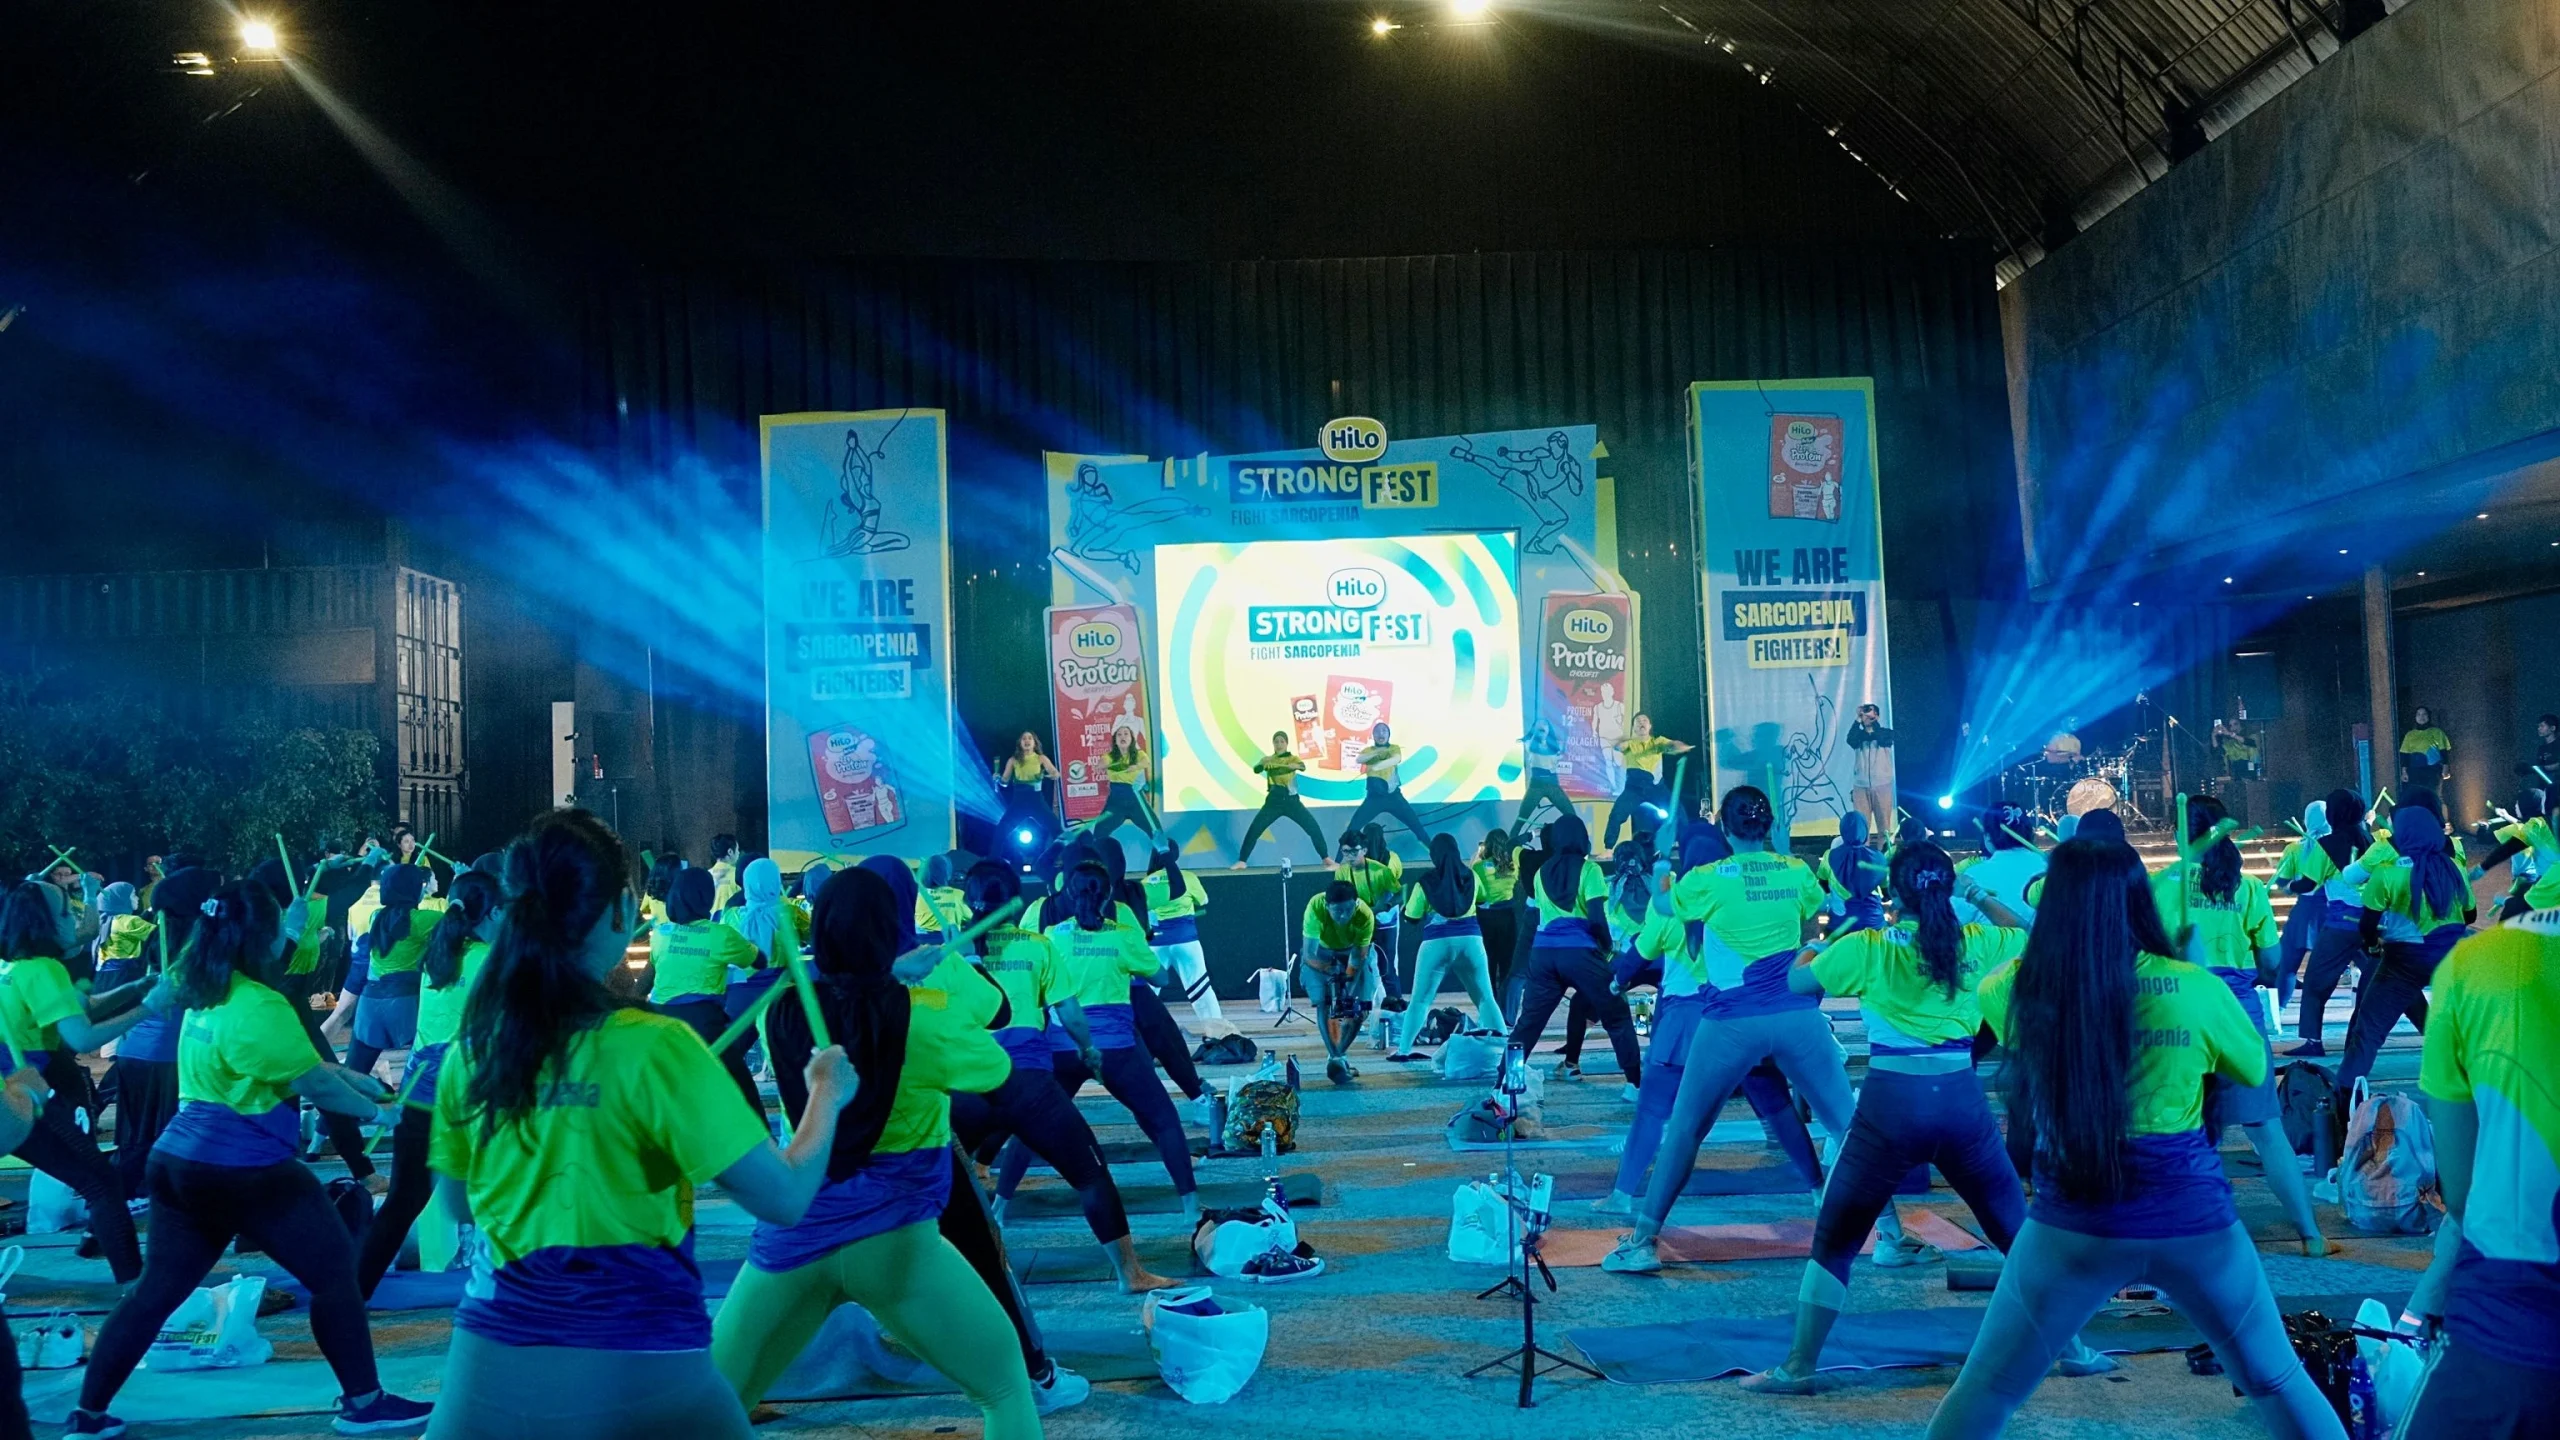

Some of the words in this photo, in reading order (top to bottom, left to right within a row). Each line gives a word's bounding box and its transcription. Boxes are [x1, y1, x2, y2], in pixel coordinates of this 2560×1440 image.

[1330, 425, 1379, 449] HiLo
[1791, 426, 1812, 435] HiLo
[1238, 465, 1359, 499] STRONG
[1369, 470, 1431, 505] FEST
[1231, 509, 1268, 526] FIGHT
[1271, 506, 1361, 525] SARCOPENIA
[1734, 549, 1781, 586] WE
[1792, 547, 1849, 585] ARE
[1336, 578, 1378, 596] HiLo
[800, 579, 846, 618] WE
[857, 578, 914, 616] ARE
[1734, 599, 1855, 628] SARCOPENIA
[1255, 611, 1360, 639] STRONG
[1571, 617, 1608, 634] HiLo
[798, 632, 919, 660] SARCOPENIA
[1077, 631, 1115, 647] HiLo
[1250, 646, 1281, 660] FIGHT
[1284, 643, 1361, 659] SARCOPENIA
[1551, 643, 1625, 671] Protein
[1753, 637, 1842, 662] FIGHTERS!
[815, 669, 905, 694] FIGHTERS!
[1060, 657, 1138, 687] Protein
[1567, 706, 1593, 717] PROTEIN
[1084, 724, 1111, 735] PROTEIN
[1742, 860, 1789, 873] #Stronger
[1743, 874, 1767, 887] Than
[1745, 886, 1799, 902] Sarcopenia
[986, 959, 1034, 973] arcopenia
